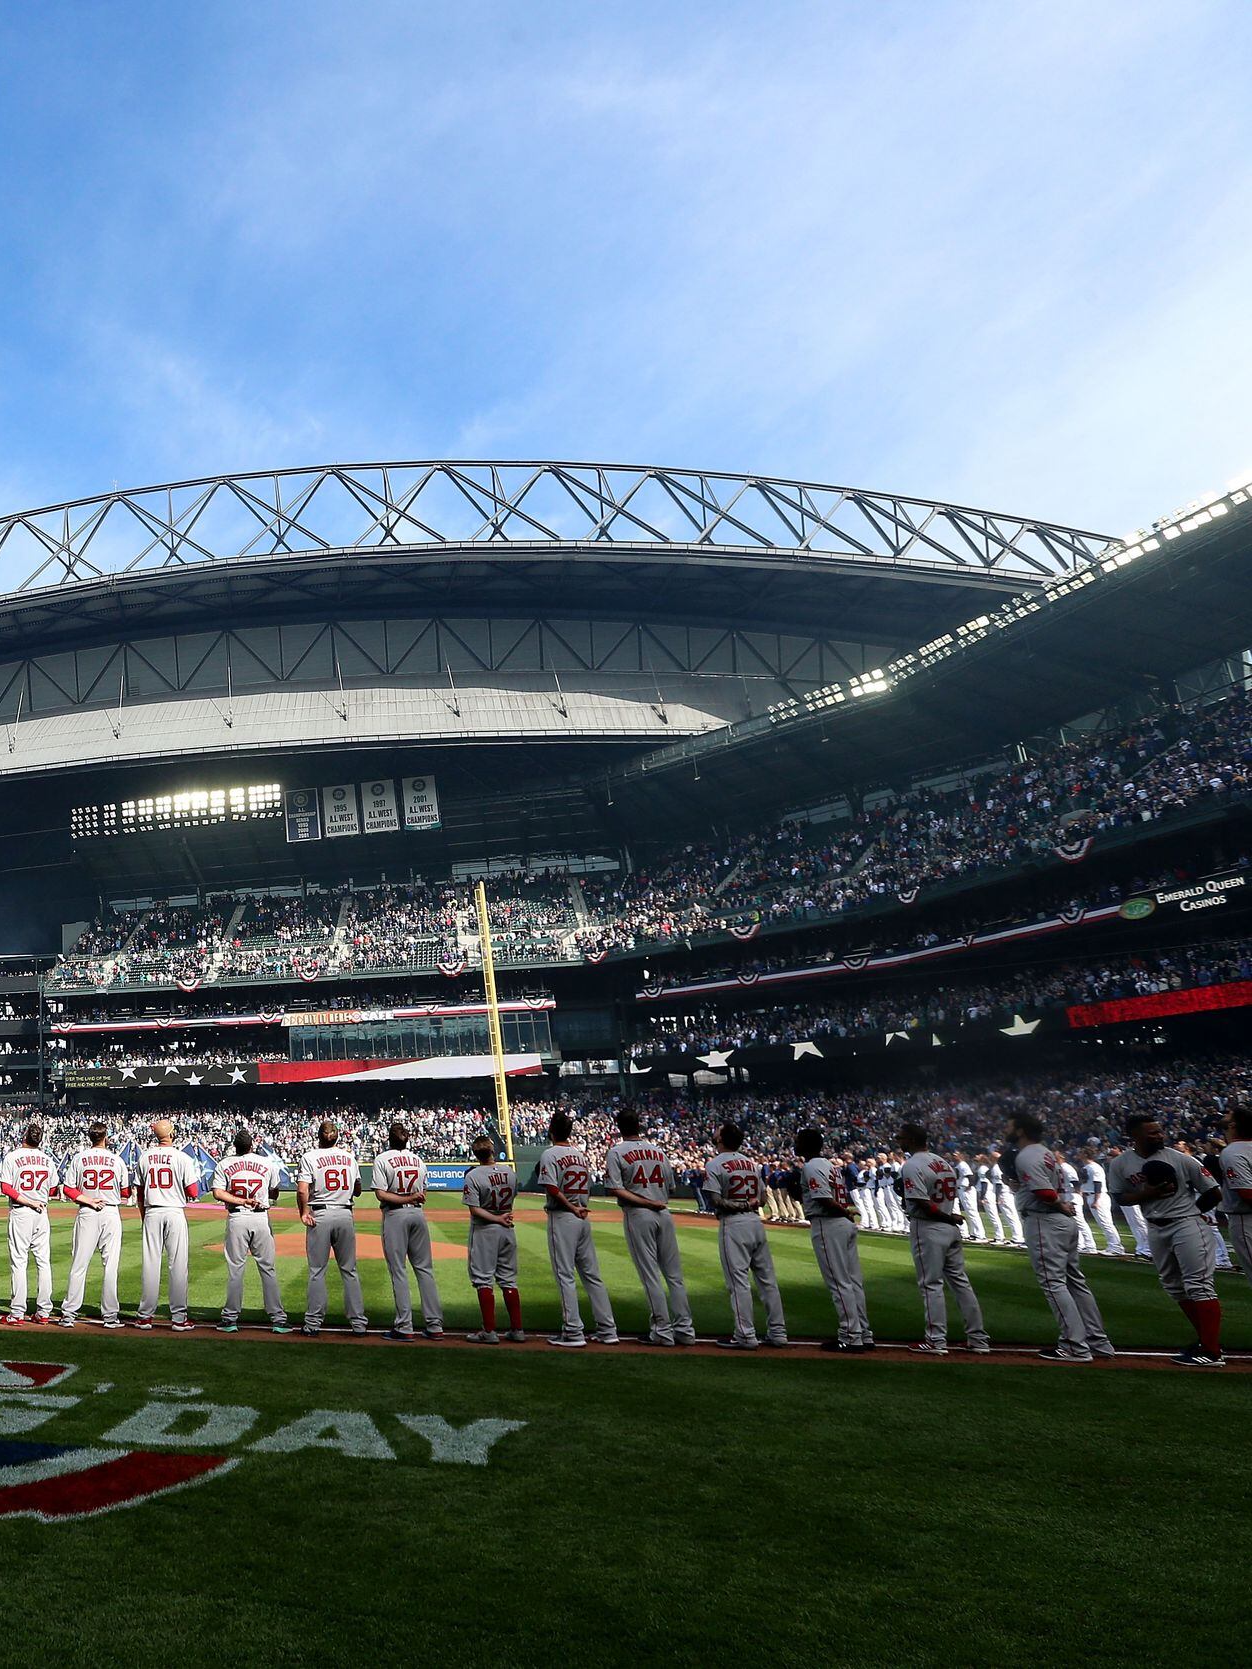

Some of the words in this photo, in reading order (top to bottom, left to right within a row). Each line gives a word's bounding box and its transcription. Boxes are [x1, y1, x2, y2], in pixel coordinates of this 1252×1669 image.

[373, 800, 386, 808] 1997
[413, 795, 427, 803] 2001
[333, 804, 348, 812] 1995
[378, 808, 393, 818] WEST
[418, 804, 434, 813] WEST
[338, 813, 354, 822] WEST
[365, 819, 397, 830] CHAMPIONS
[407, 814, 438, 824] CHAMPIONS
[326, 823, 357, 834] CHAMPIONS
[1155, 886, 1204, 904] EMERALD
[1205, 876, 1246, 893] QUEEN
[1179, 895, 1227, 912] CASINOS
[303, 1013, 316, 1022] HIT
[319, 1012, 327, 1022] IT
[329, 1011, 347, 1021] HERE
[15, 1155, 50, 1168] HEMBREE
[82, 1156, 115, 1167] BARNES
[148, 1154, 172, 1165] PRICE
[317, 1156, 352, 1169] JOHNSON
[388, 1156, 420, 1169] EOVALDI
[557, 1154, 588, 1171] PORCELL
[622, 1149, 664, 1165] WORKMAN
[223, 1161, 269, 1178] RODRIGUEZ
[721, 1159, 757, 1173] SWIHART
[19, 1170, 49, 1191] 37
[82, 1169, 114, 1190] 32
[149, 1168, 173, 1189] 10
[325, 1169, 350, 1191] 61
[396, 1170, 418, 1193] 17
[427, 1170, 466, 1179] nsuranc
[488, 1173, 509, 1187] HOLT
[632, 1164, 664, 1188] 44
[563, 1170, 588, 1194] 22
[729, 1175, 759, 1199] 23
[231, 1179, 263, 1200] 57
[490, 1187, 513, 1210] 12
[100, 1401, 528, 1466] DAY
